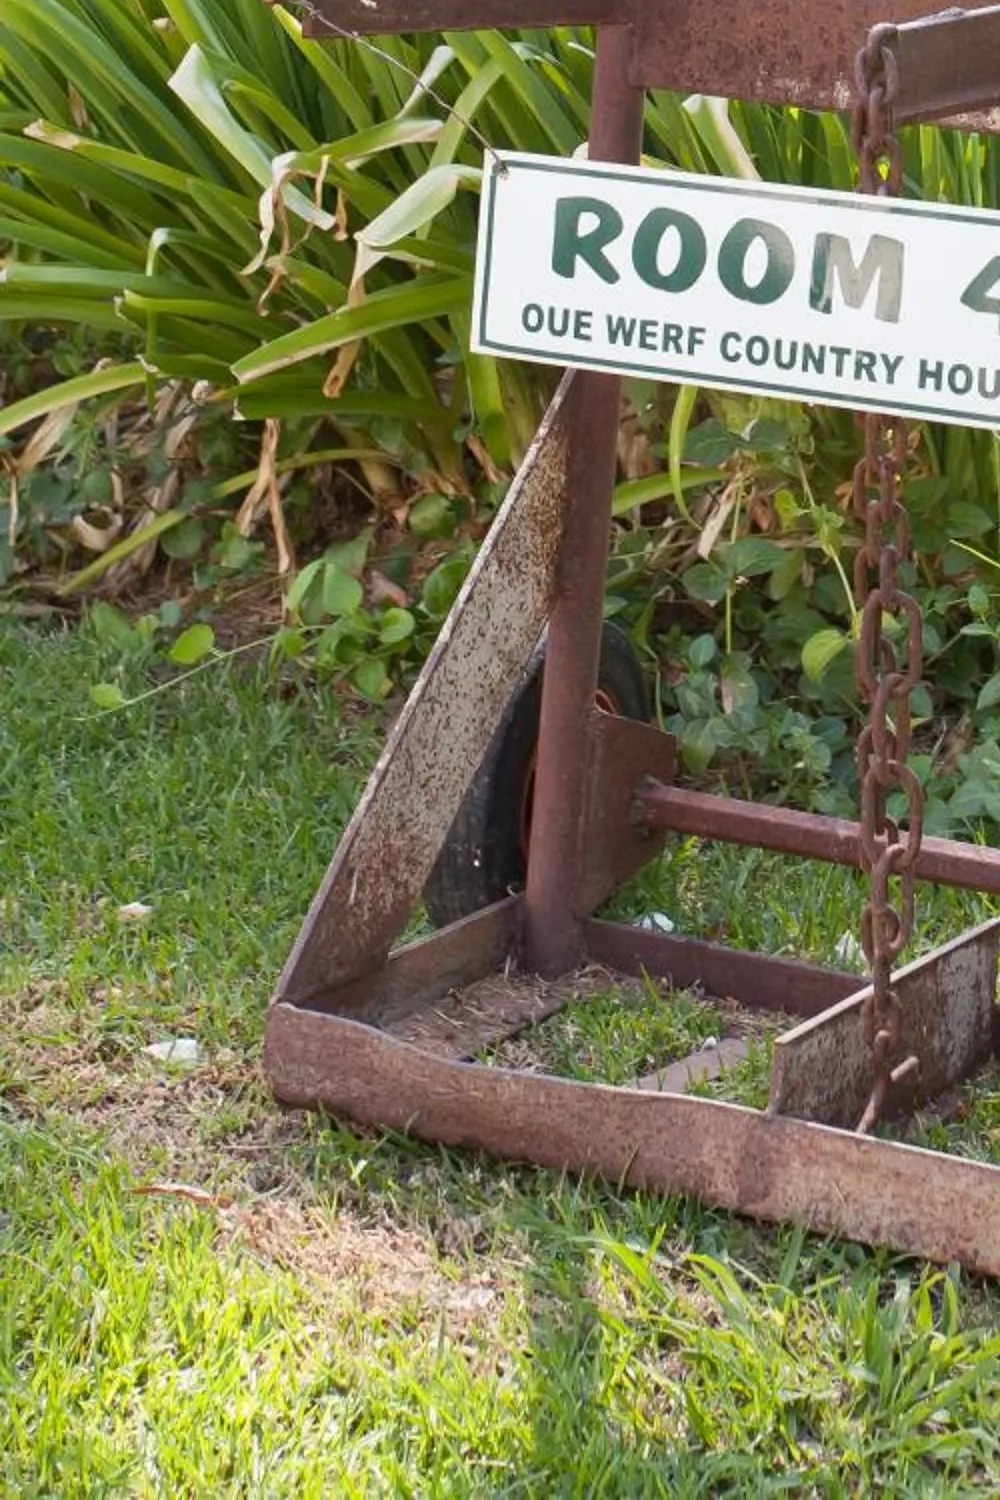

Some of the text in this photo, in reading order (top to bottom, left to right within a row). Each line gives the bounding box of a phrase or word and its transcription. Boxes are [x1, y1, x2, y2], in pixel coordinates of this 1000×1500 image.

[552, 196, 904, 323] ROOM
[522, 303, 593, 342] OUE
[606, 314, 706, 356] WERF
[720, 331, 904, 385] COUNTRY
